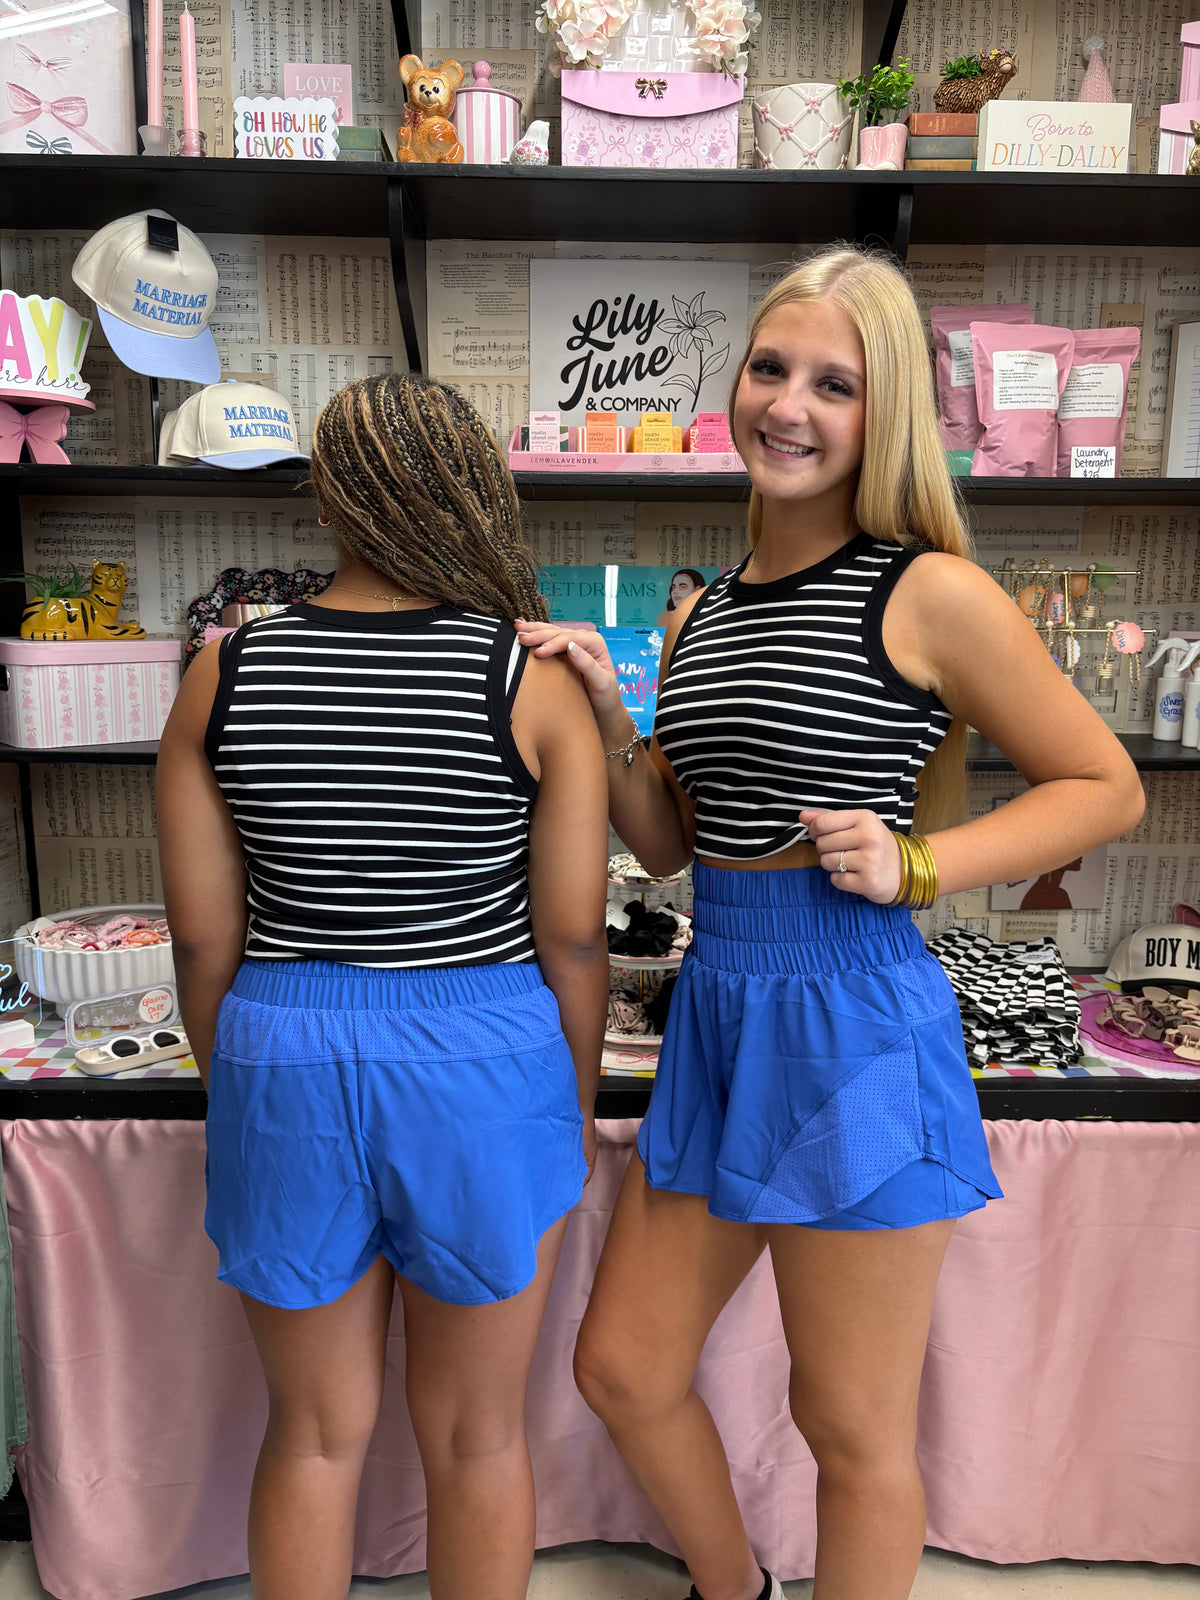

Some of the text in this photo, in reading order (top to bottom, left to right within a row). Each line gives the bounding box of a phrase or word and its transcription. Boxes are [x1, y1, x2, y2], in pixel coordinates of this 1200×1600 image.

[295, 75, 342, 93] LOVE
[243, 111, 265, 132] OH
[272, 112, 305, 133] HOW
[1026, 114, 1094, 141] Born to
[303, 137, 324, 158] US
[991, 143, 1125, 168] DILLY-DALLY
[482, 251, 513, 259] Barefoot
[134, 279, 208, 308] MARRIAGE
[132, 298, 203, 325] MATERIAL
[566, 293, 665, 351] Lily
[36, 365, 88, 390] here
[558, 346, 675, 411] June
[223, 405, 291, 425] MARRIAGE
[585, 397, 682, 412] & COMPANY
[229, 423, 293, 442] MATERIAL
[1074, 457, 1114, 471] Detergent
[1076, 448, 1109, 460] Laundry
[580, 581, 657, 597] DRAMS
[1115, 629, 1126, 648] Diva
[1145, 937, 1182, 967] BOY
[0, 981, 31, 1012] ul
